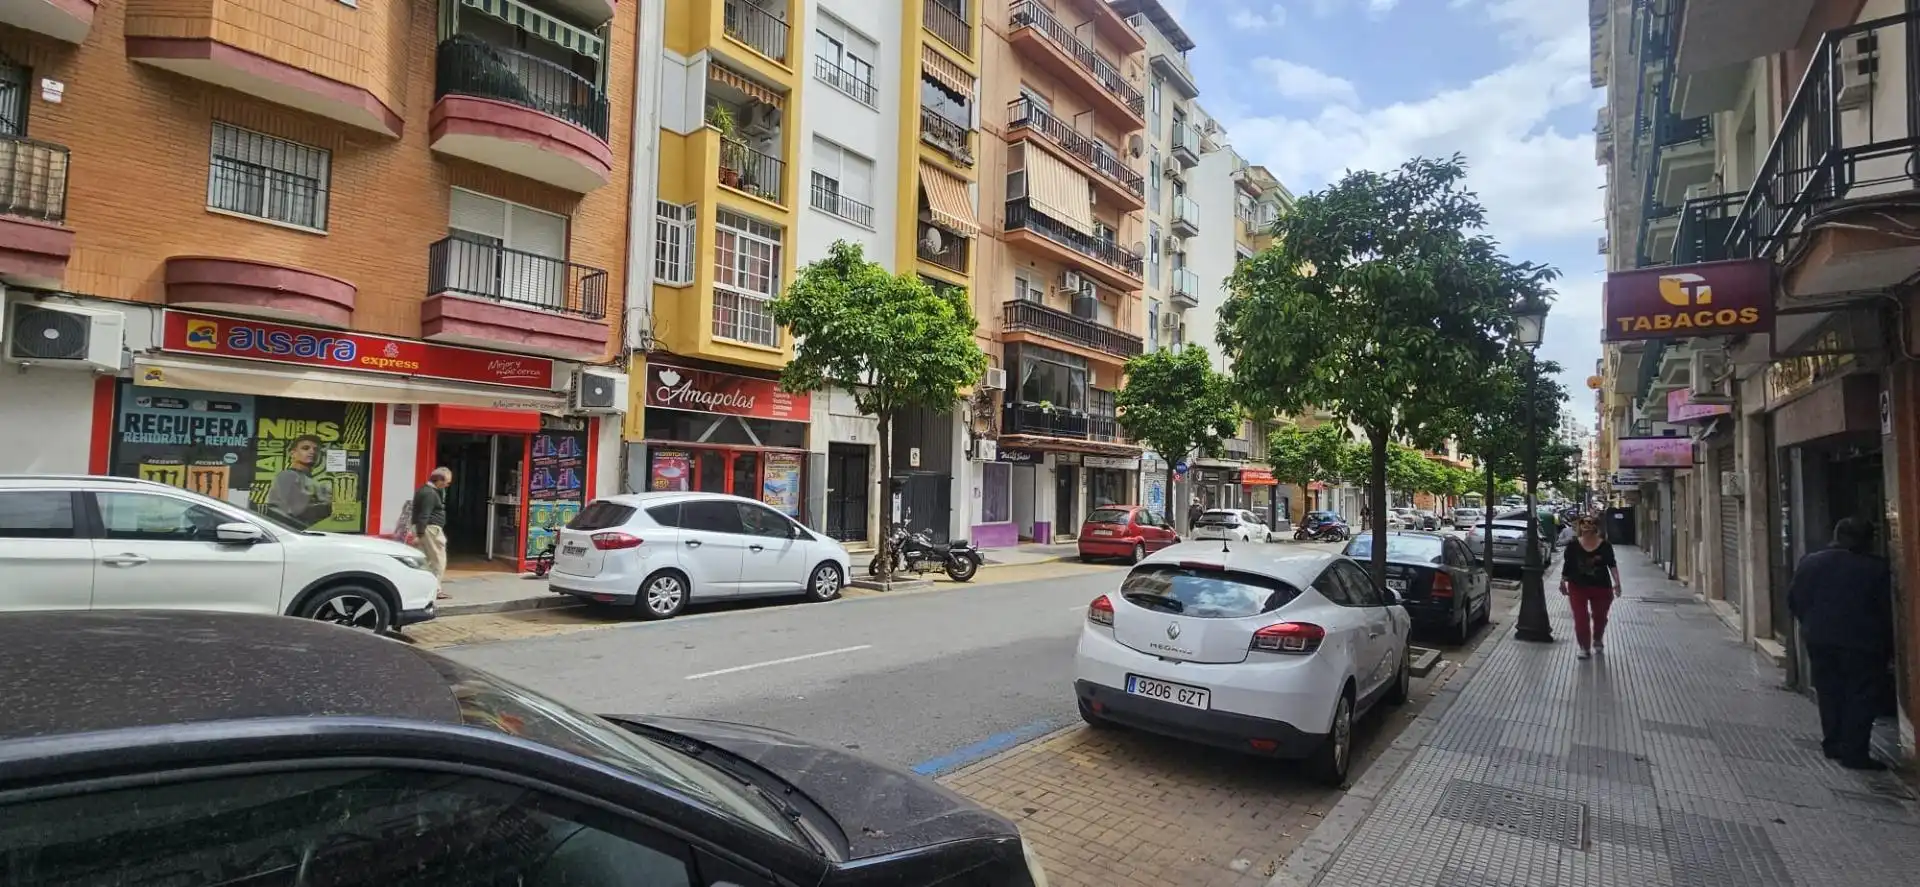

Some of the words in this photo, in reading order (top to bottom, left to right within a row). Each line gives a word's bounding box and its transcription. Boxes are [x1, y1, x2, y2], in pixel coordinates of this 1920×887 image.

[1616, 307, 1760, 332] TABACOS
[227, 326, 357, 361] alsara
[361, 355, 419, 370] express
[657, 379, 756, 411] Amapolas
[125, 412, 249, 437] RECUPERA
[123, 432, 191, 444] REHIDRATA
[205, 435, 249, 447] REPONE
[1138, 680, 1171, 699] 9206
[1178, 688, 1206, 707] GZT
